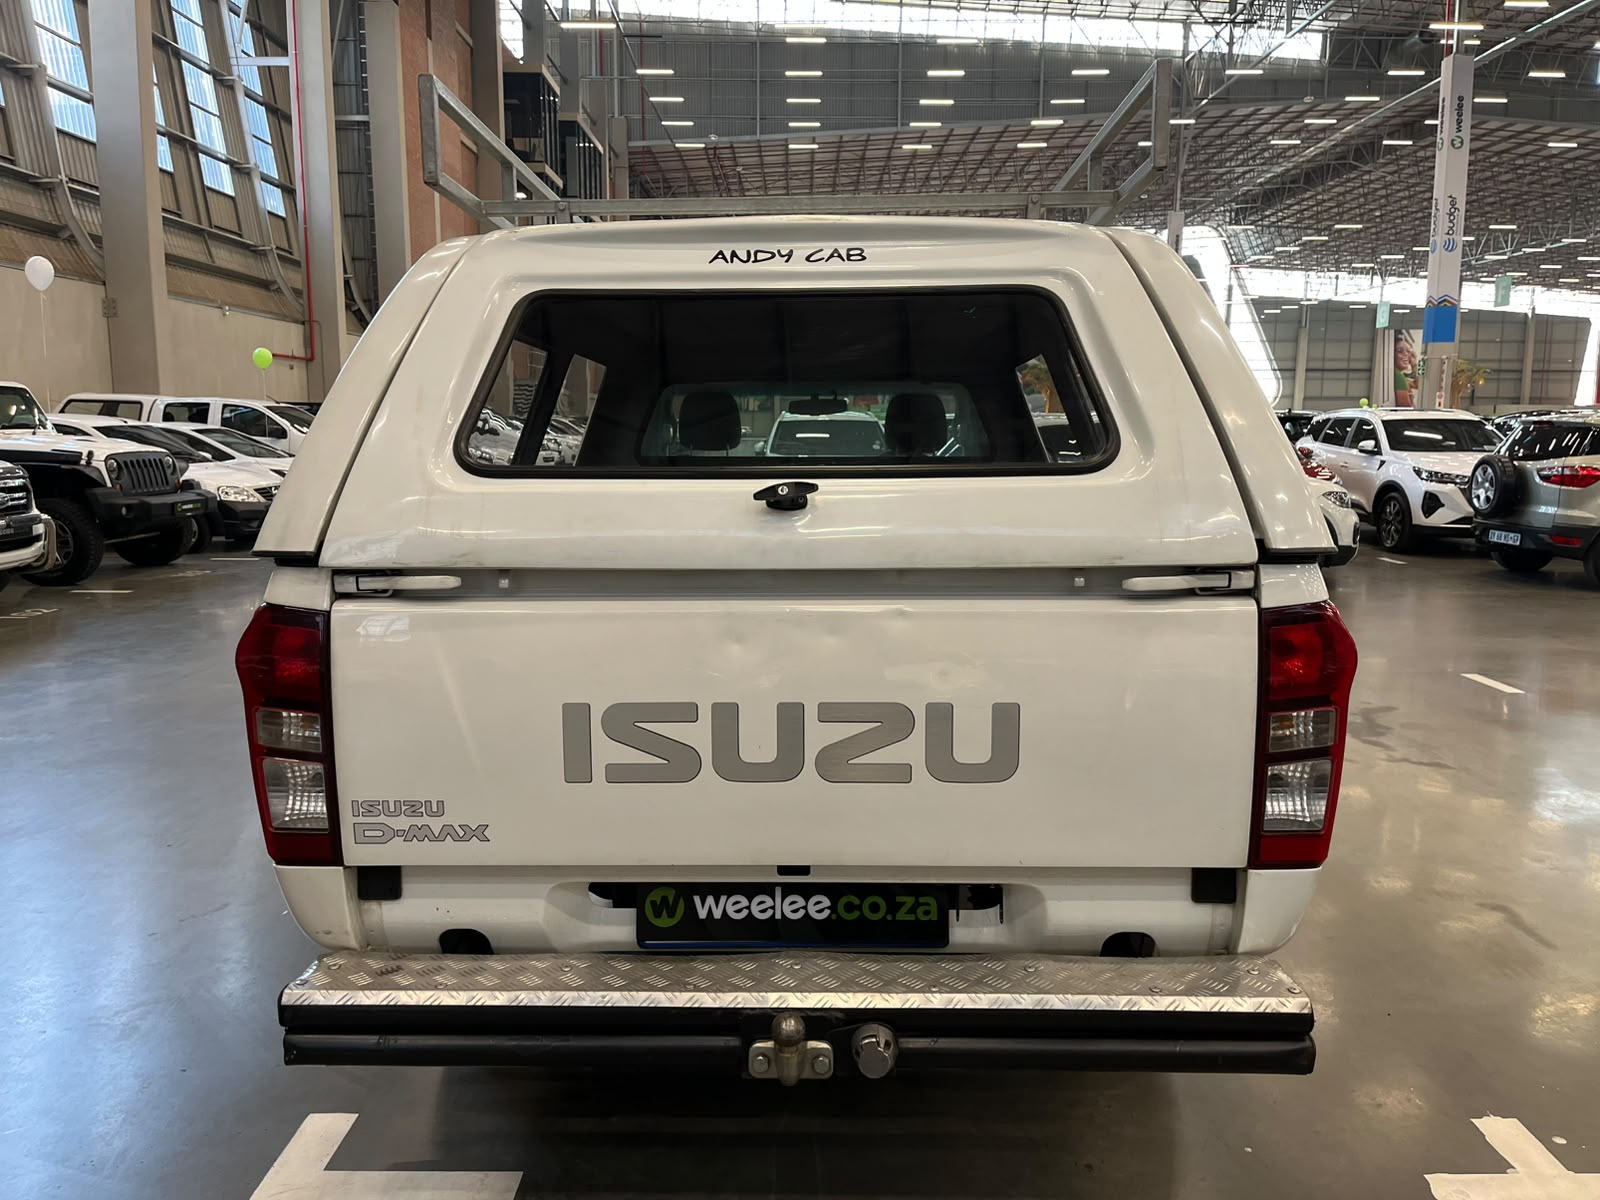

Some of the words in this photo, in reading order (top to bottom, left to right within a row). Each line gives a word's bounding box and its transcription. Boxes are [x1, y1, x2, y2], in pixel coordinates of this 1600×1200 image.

[1455, 95, 1465, 133] weelee
[1444, 194, 1460, 236] budget
[708, 249, 794, 263] ANDY
[805, 247, 867, 262] CAB
[561, 702, 1020, 784] ISUZU
[351, 799, 445, 817] ISUZU
[353, 822, 490, 844] D-MAX
[693, 886, 938, 920] weelee.co.za
